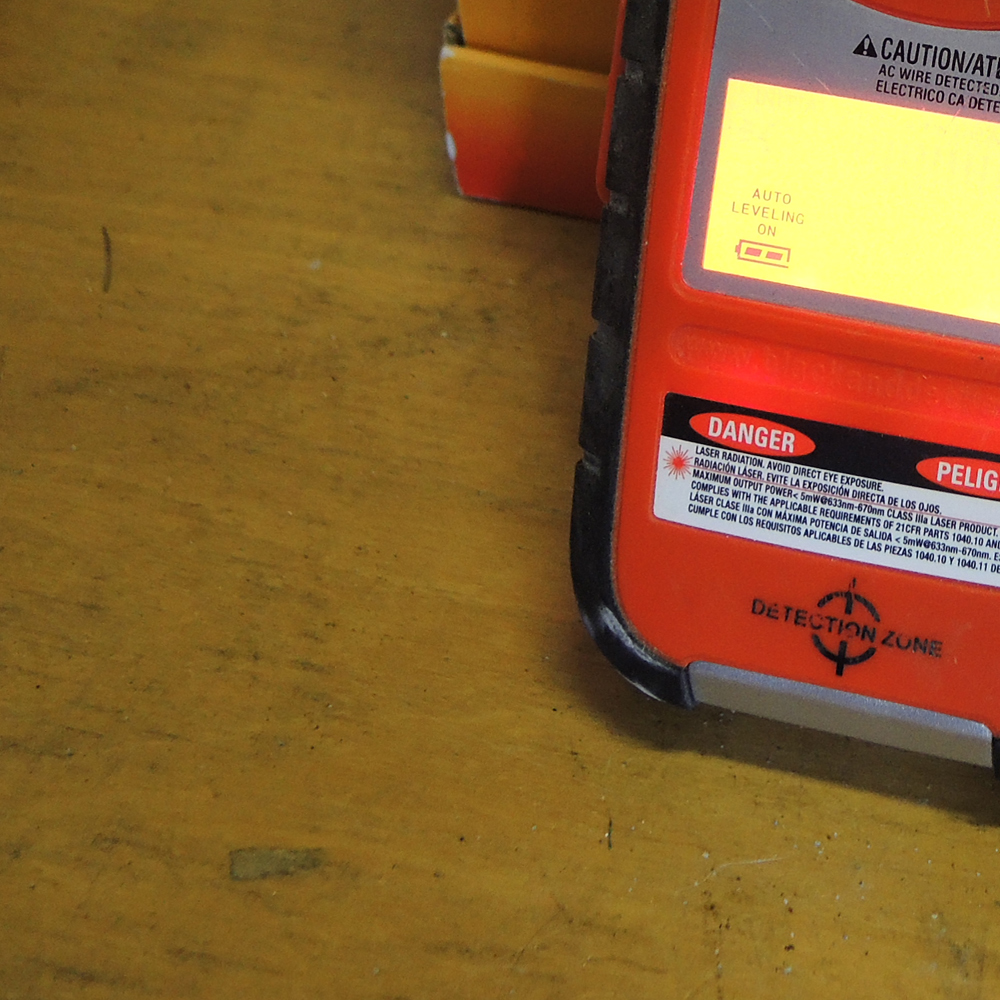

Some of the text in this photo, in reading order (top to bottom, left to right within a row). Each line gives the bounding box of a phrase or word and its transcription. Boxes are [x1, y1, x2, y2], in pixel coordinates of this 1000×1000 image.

[876, 80, 944, 104] ELECTRICO
[947, 92, 965, 107] CA
[878, 64, 895, 78] AC
[900, 66, 932, 85] WIRE
[731, 201, 805, 225] LEVELING
[752, 188, 792, 205] AUTO
[757, 223, 777, 237] ON
[708, 416, 797, 453] DANGER
[694, 457, 942, 515] RADIACIÓN LÁSER. EVITE LA EXPOSICIÓN DIRECTA DE LOS OJOS.
[695, 445, 884, 492] LASER RADIATION. AVOID DIRECT EYE EXPOSURE.
[689, 492, 714, 505] LÁSER
[715, 497, 740, 511] CLASE
[756, 506, 773, 518] CON
[774, 510, 807, 525] MÁXIMA
[809, 517, 848, 533] POTENCIA
[850, 525, 862, 535] DE
[863, 528, 892, 541] SALIDA
[691, 480, 729, 497] COMPLIES
[732, 489, 752, 502] WITH
[754, 493, 768, 505] THE
[769, 497, 818, 515] APPLICABLE
[819, 507, 881, 527] REQUIREMENTS
[883, 519, 894, 529] OF
[895, 522, 921, 535] 21CFR
[923, 527, 950, 540] PARTS
[952, 532, 984, 546] 1040.10
[692, 468, 731, 485] MAXIMUM
[733, 477, 763, 492] OUTPUT
[886, 507, 913, 521] CLASS
[930, 516, 957, 529] LASER
[958, 521, 998, 537] PRODUCT.
[688, 503, 719, 519] CUMPLE
[720, 510, 737, 522] CON
[738, 514, 754, 526] LOS
[755, 518, 802, 536] REQUISITOS
[803, 528, 852, 546] APLICABLES
[853, 538, 865, 549] DE
[866, 540, 882, 552] LAS
[884, 544, 913, 558] PIEZAS
[916, 550, 947, 564] 1040.10
[957, 557, 988, 572] 1040.11
[751, 598, 943, 658] DETECTION ZONE
